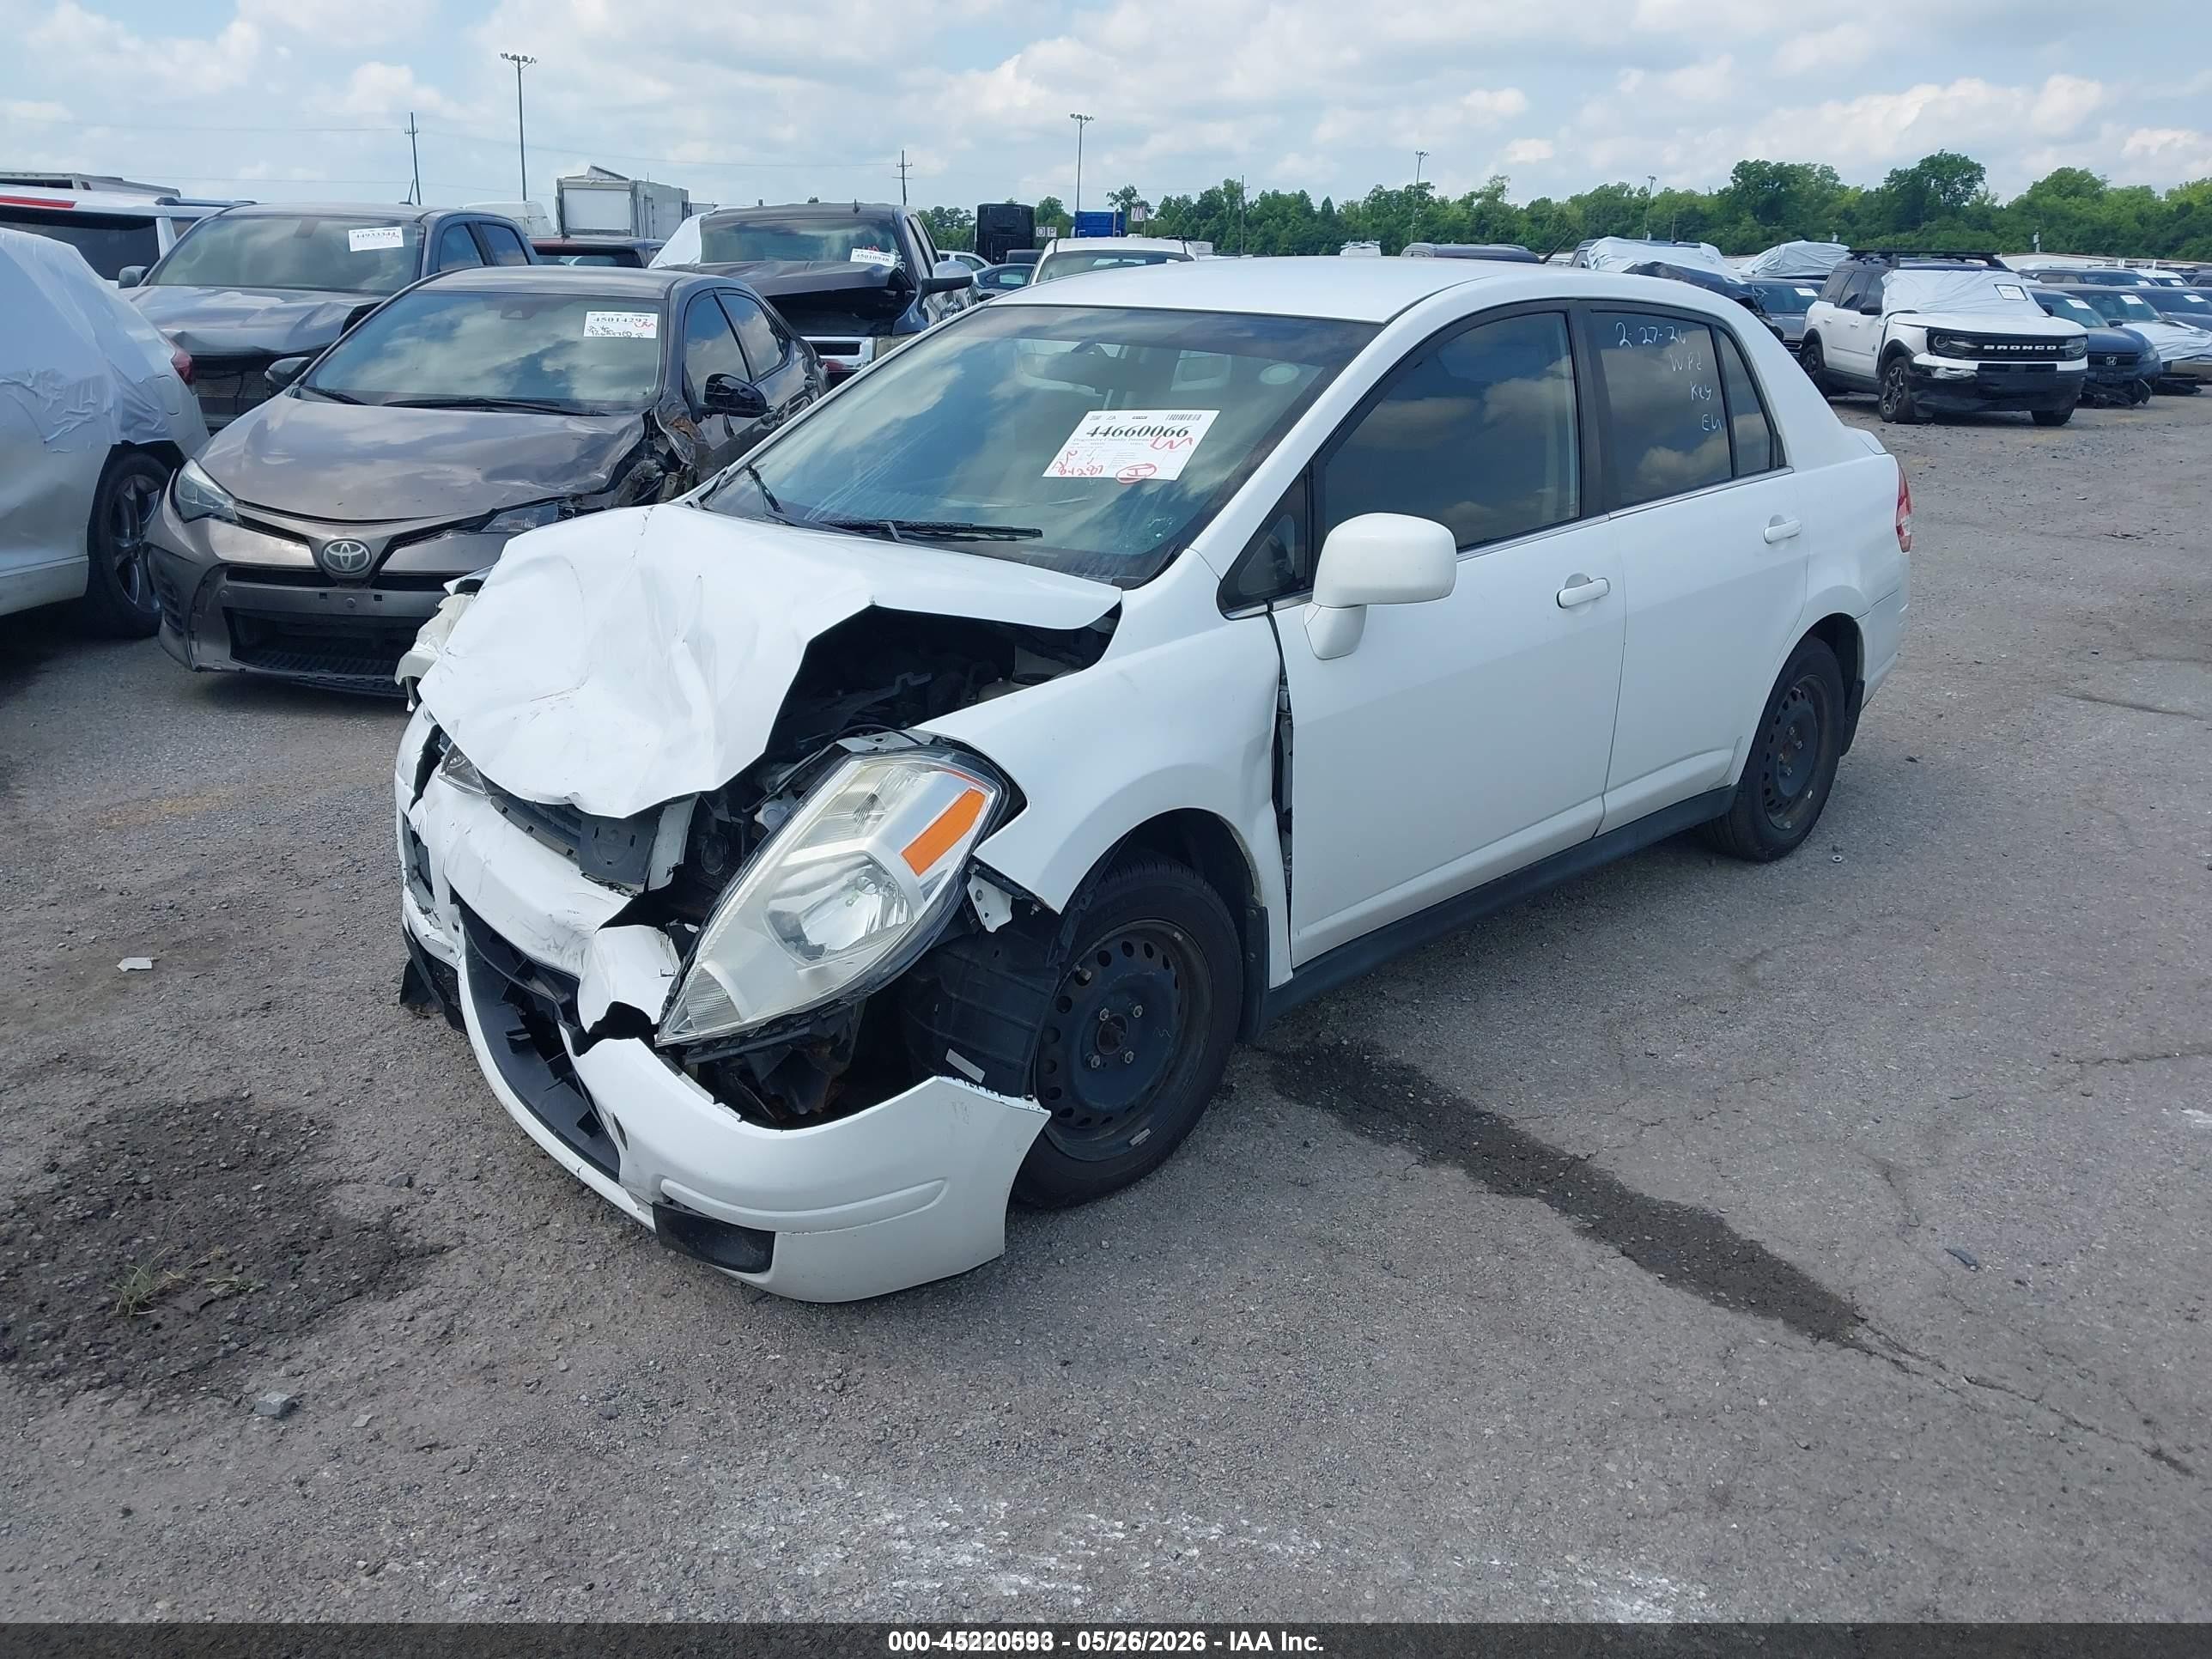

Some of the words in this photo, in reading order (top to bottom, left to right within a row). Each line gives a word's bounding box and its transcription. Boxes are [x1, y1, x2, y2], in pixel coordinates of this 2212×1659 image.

[1133, 207, 1144, 220] 70
[1049, 228, 1055, 236] P
[1086, 425, 1191, 437] 44660066
